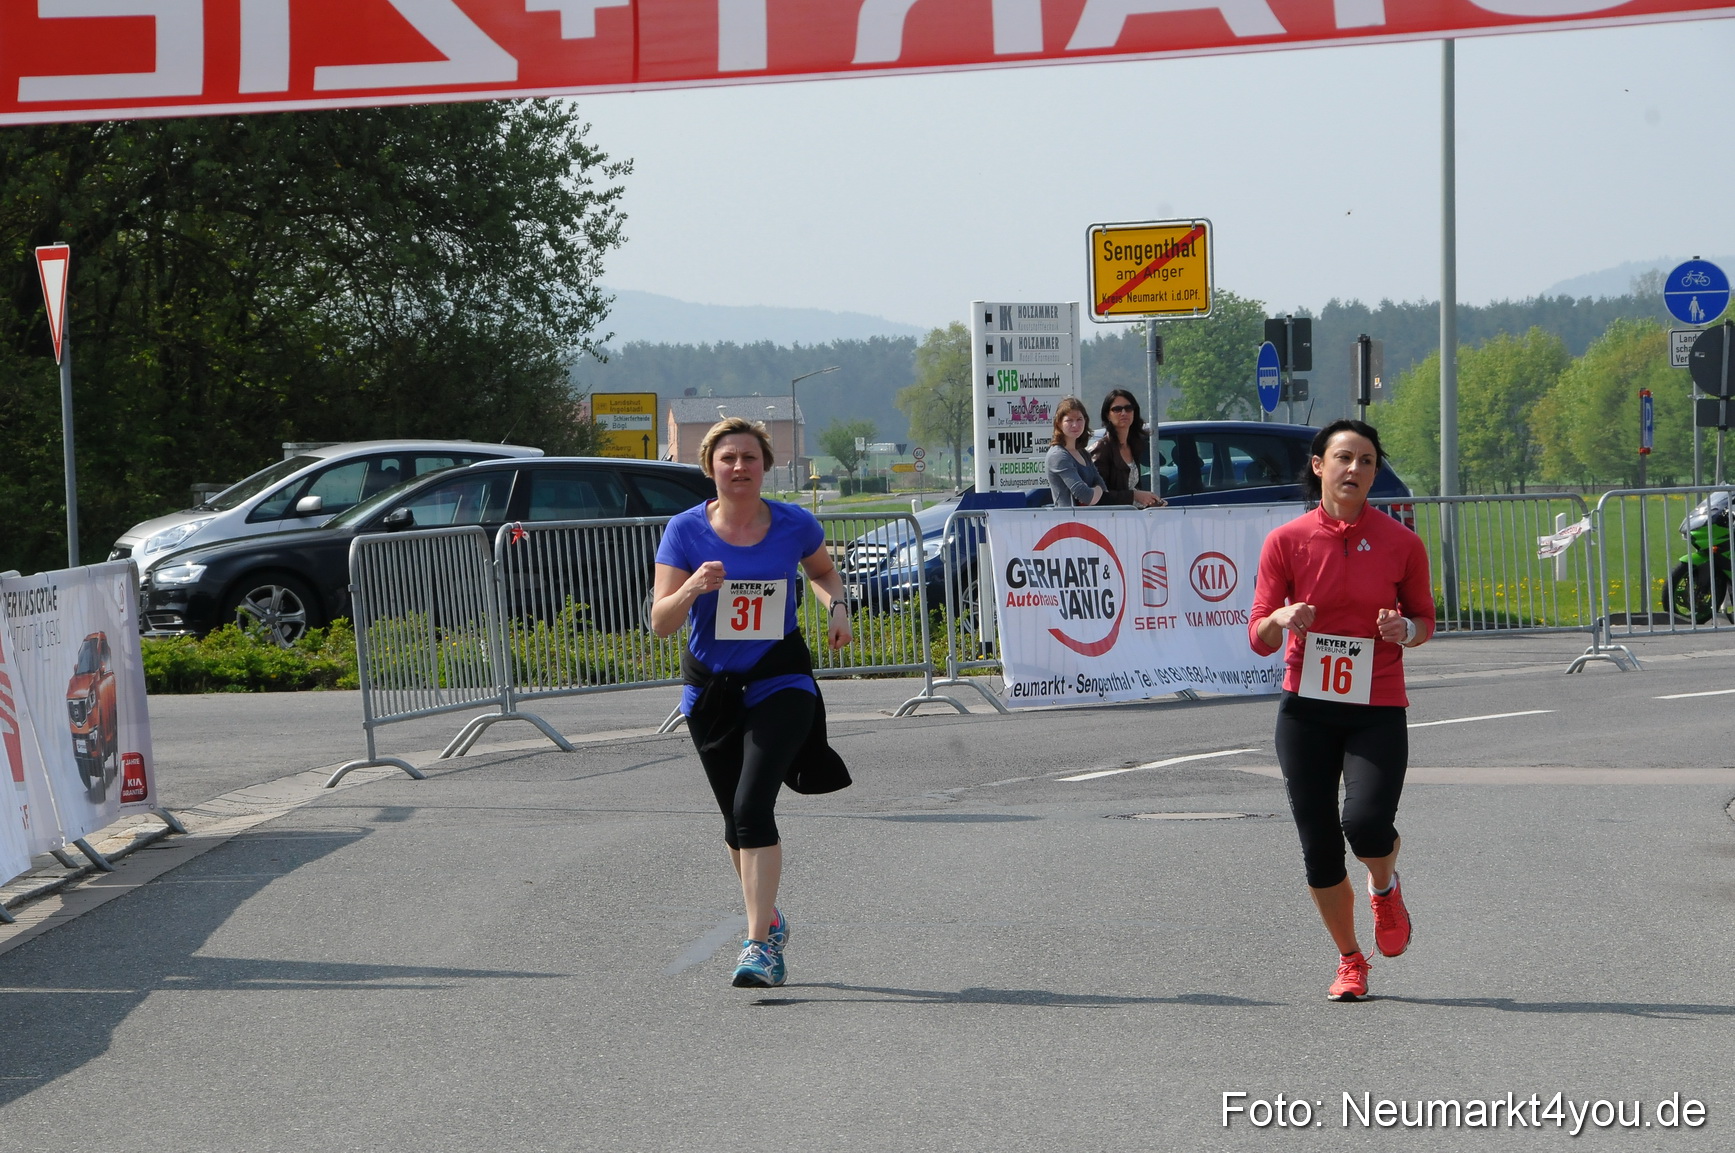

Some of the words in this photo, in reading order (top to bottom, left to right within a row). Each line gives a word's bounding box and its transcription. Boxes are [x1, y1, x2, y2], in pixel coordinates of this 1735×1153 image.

[1104, 236, 1196, 266] Sengenthal
[1117, 269, 1136, 280] am
[1143, 266, 1184, 281] Anger
[1102, 293, 1122, 304] Kreis
[1127, 290, 1168, 303] Neumarkt
[1018, 306, 1058, 318] HOLZAMMER
[1019, 337, 1059, 349] HOLZAMMER
[1679, 334, 1698, 343] Land
[1676, 354, 1689, 363] Ver
[998, 370, 1018, 393] SHB
[1020, 372, 1060, 388] Holzfachmarkt
[998, 432, 1033, 454] THULE
[1000, 461, 1045, 475] HEIDELBERGCE
[1006, 557, 1099, 589] GERHART
[1103, 564, 1110, 580] &
[1198, 564, 1229, 590] KIA
[1006, 591, 1059, 608] Autohaus
[1059, 589, 1115, 620] JÄNIG
[731, 596, 763, 631] 31
[1185, 612, 1204, 627] KIA
[1206, 610, 1249, 627] MOTORS
[1135, 616, 1177, 630] SEAT
[1316, 638, 1347, 648] MEYER
[1316, 645, 1347, 654] WERBUNG
[1320, 655, 1353, 695] 16
[1010, 675, 1066, 697] eumarkt
[1076, 671, 1131, 697] Sengenthal
[127, 778, 142, 787] KIA
